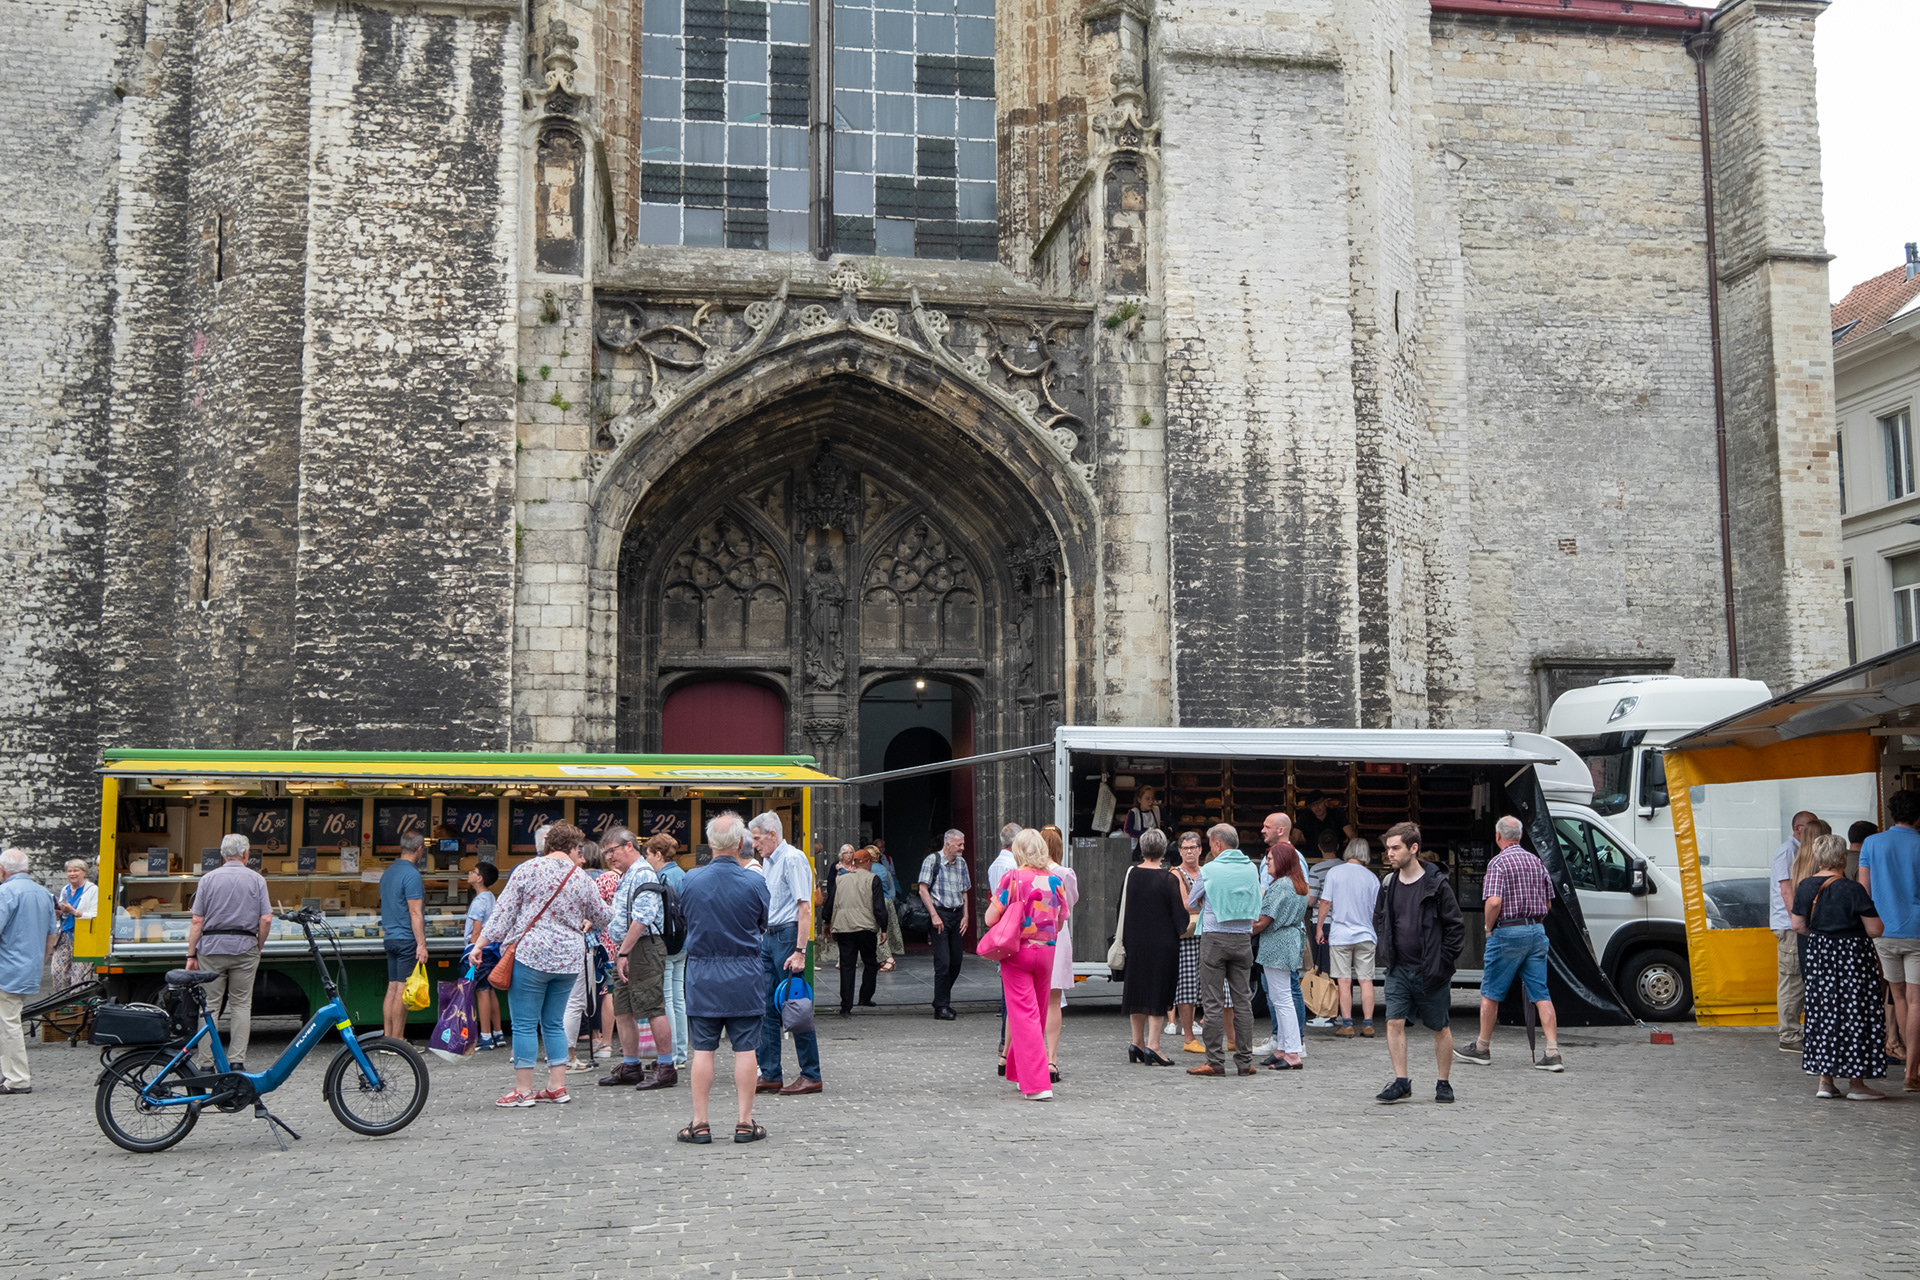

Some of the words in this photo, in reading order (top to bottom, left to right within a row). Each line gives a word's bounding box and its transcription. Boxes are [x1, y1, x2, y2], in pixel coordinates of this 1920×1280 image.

[252, 811, 287, 834] 15,95
[322, 812, 357, 835] 16,95
[396, 813, 427, 834] 1795
[461, 812, 494, 834] 19,95
[592, 812, 624, 833] 2195
[650, 814, 687, 835] 22,95
[295, 1022, 317, 1049] FLYER
